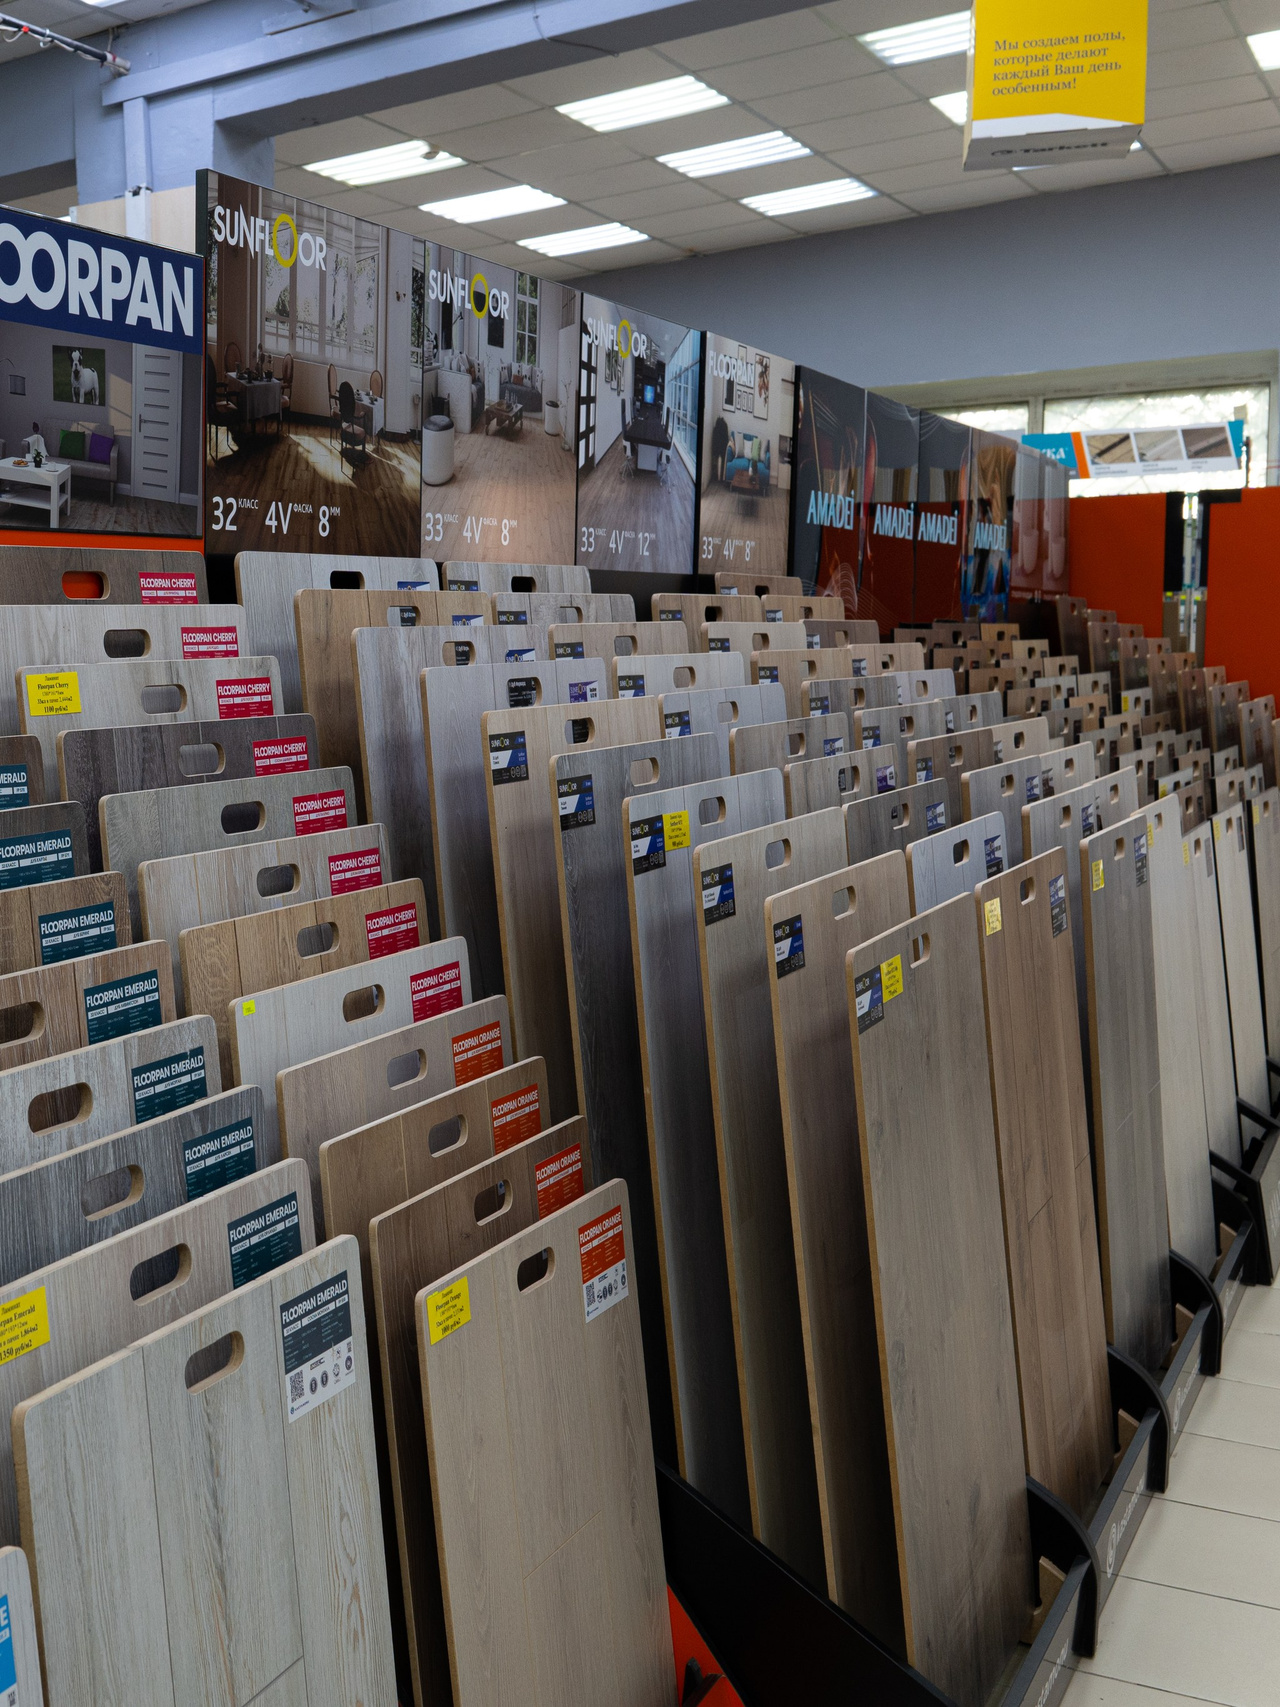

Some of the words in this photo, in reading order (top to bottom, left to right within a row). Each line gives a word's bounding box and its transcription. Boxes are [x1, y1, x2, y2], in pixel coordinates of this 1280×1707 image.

[994, 39, 1019, 52] Мы
[1023, 35, 1079, 48] создаем
[1083, 30, 1126, 44] полы,
[993, 52, 1053, 67] которые
[1056, 47, 1109, 62] делают
[993, 65, 1049, 82] каждый
[1054, 64, 1084, 76] Ваш
[1087, 61, 1122, 74] день
[992, 77, 1077, 96] особенным!
[213, 203, 327, 271] SUNFLOOR
[428, 267, 509, 320] SUNFLOOR
[587, 316, 647, 359] SUNFLOOR
[708, 351, 754, 389] FLOORPAN
[211, 496, 238, 531] 32
[238, 498, 259, 510] КЛАСС
[265, 501, 293, 535] 4V
[293, 503, 313, 514] ФАСКА
[318, 505, 330, 538] 8
[424, 512, 443, 542] 33
[462, 516, 483, 544] 4V
[501, 518, 510, 546] 8
[580, 526, 595, 553] 33
[608, 529, 625, 554] 4V
[637, 531, 650, 556] 12
[702, 536, 714, 559] 33
[723, 538, 736, 560] 4V
[140, 577, 171, 587] FLOORPAN
[171, 578, 194, 587] CHERRY
[182, 632, 212, 642] FLOORPAN
[212, 632, 236, 642] CHERRY
[217, 684, 247, 695] FLOORPAN
[247, 682, 269, 693] CHERRY
[254, 744, 283, 757] FLOORPAN
[283, 742, 306, 753] CHERRY
[294, 799, 322, 812] FLOORPAN
[322, 795, 344, 808] CHERRY
[36, 836, 71, 852] EMERALD
[329, 857, 357, 872] FLOORPAN
[357, 854, 378, 866] CHERRY
[40, 916, 78, 934] FLOORPAN
[79, 909, 113, 926] EMERALD
[366, 914, 394, 930] FLOORPAN
[394, 908, 415, 922] CHERRY
[411, 974, 438, 991] FLOORPAN
[438, 967, 459, 982] CHERRY
[86, 986, 123, 1007] FLOORPAN
[124, 977, 157, 996] EMERALD
[453, 1035, 478, 1053] FLOORPAN
[478, 1027, 500, 1043] ORANGE
[133, 1065, 170, 1088] FLOORPAN
[170, 1054, 203, 1075] EMERALD
[492, 1098, 517, 1117] FLOORPAN
[517, 1089, 538, 1106] ORANGE
[184, 1137, 220, 1161] FLOORPAN
[220, 1125, 252, 1147] EMERALD
[535, 1160, 560, 1181] FLOORPAN
[560, 1149, 580, 1167] ORANGE
[229, 1215, 265, 1242] FLOORPAN
[265, 1200, 296, 1224] EMERALD
[579, 1222, 602, 1244] FLOORPAN
[602, 1211, 621, 1230] ORANGE
[13, 1304, 36, 1321] Emerald
[282, 1295, 316, 1324] FLOORPAN
[316, 1279, 347, 1305] EMERALD
[0, 1346, 14, 1361] 1350
